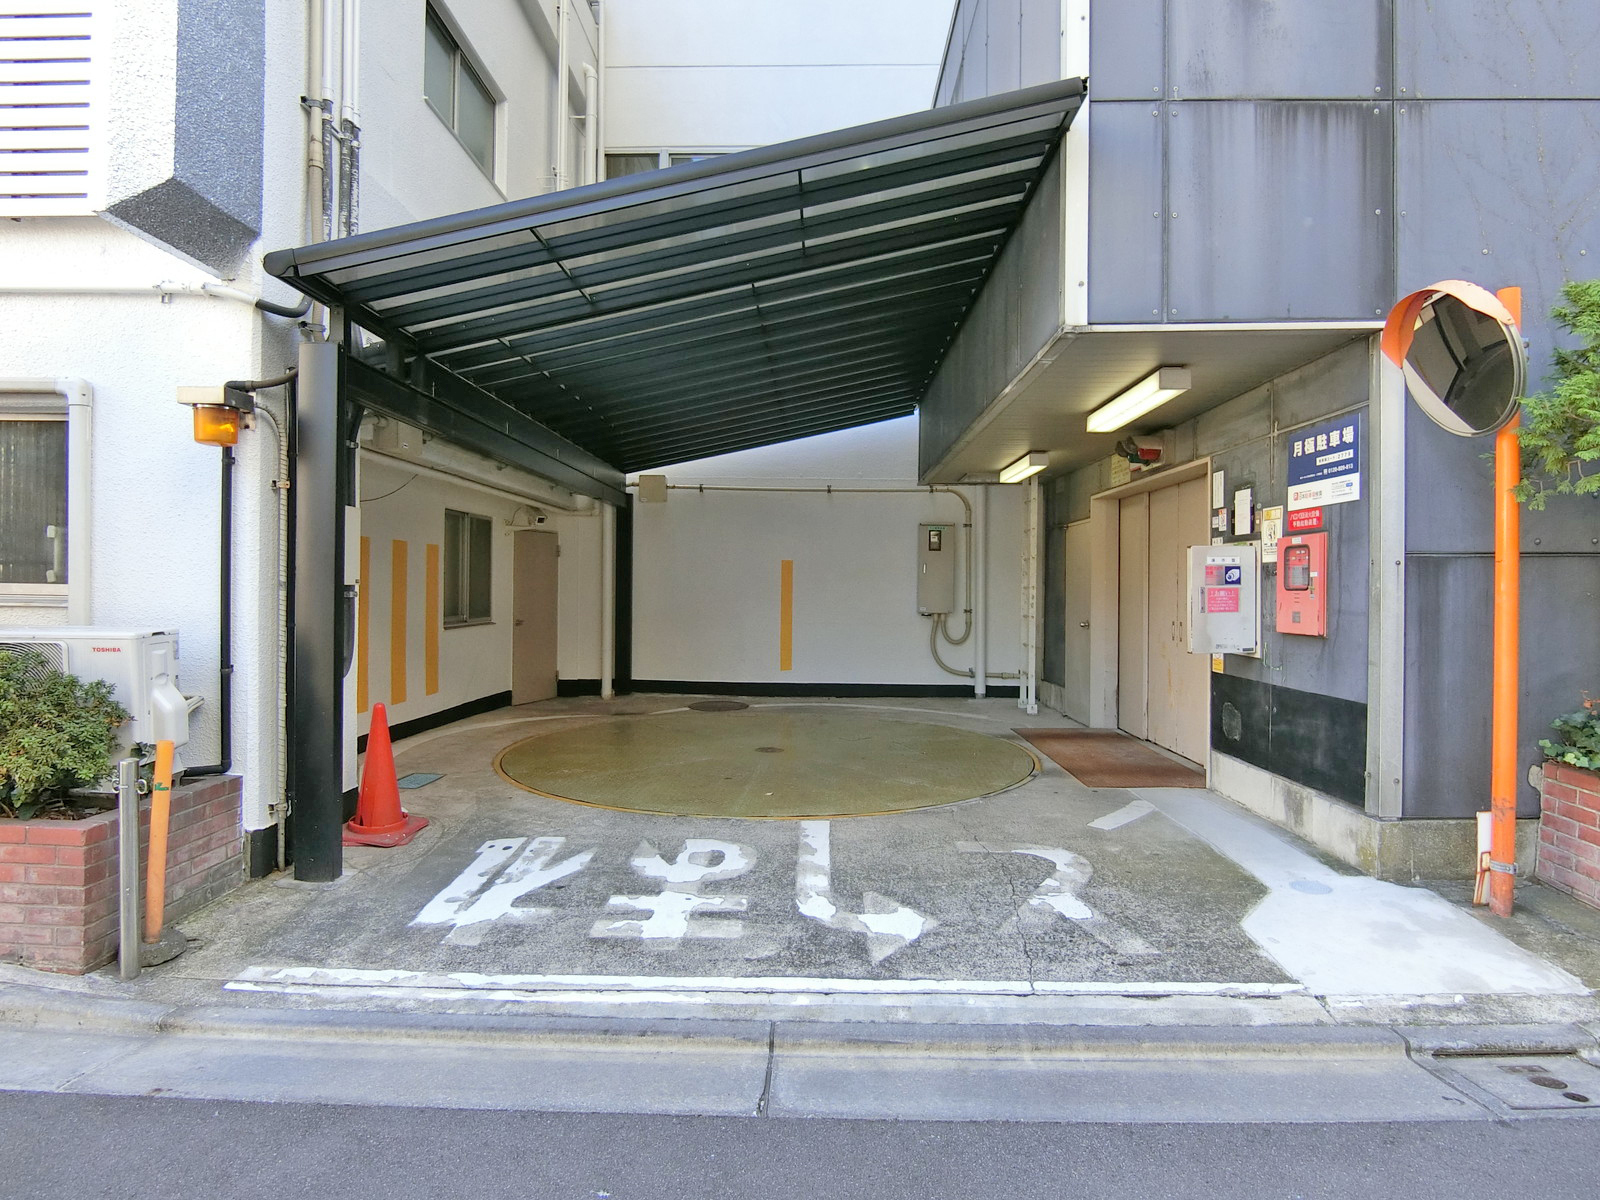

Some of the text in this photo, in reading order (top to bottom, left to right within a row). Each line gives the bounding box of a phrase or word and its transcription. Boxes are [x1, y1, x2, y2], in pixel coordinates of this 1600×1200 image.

[1293, 425, 1354, 457] 月極駐車場
